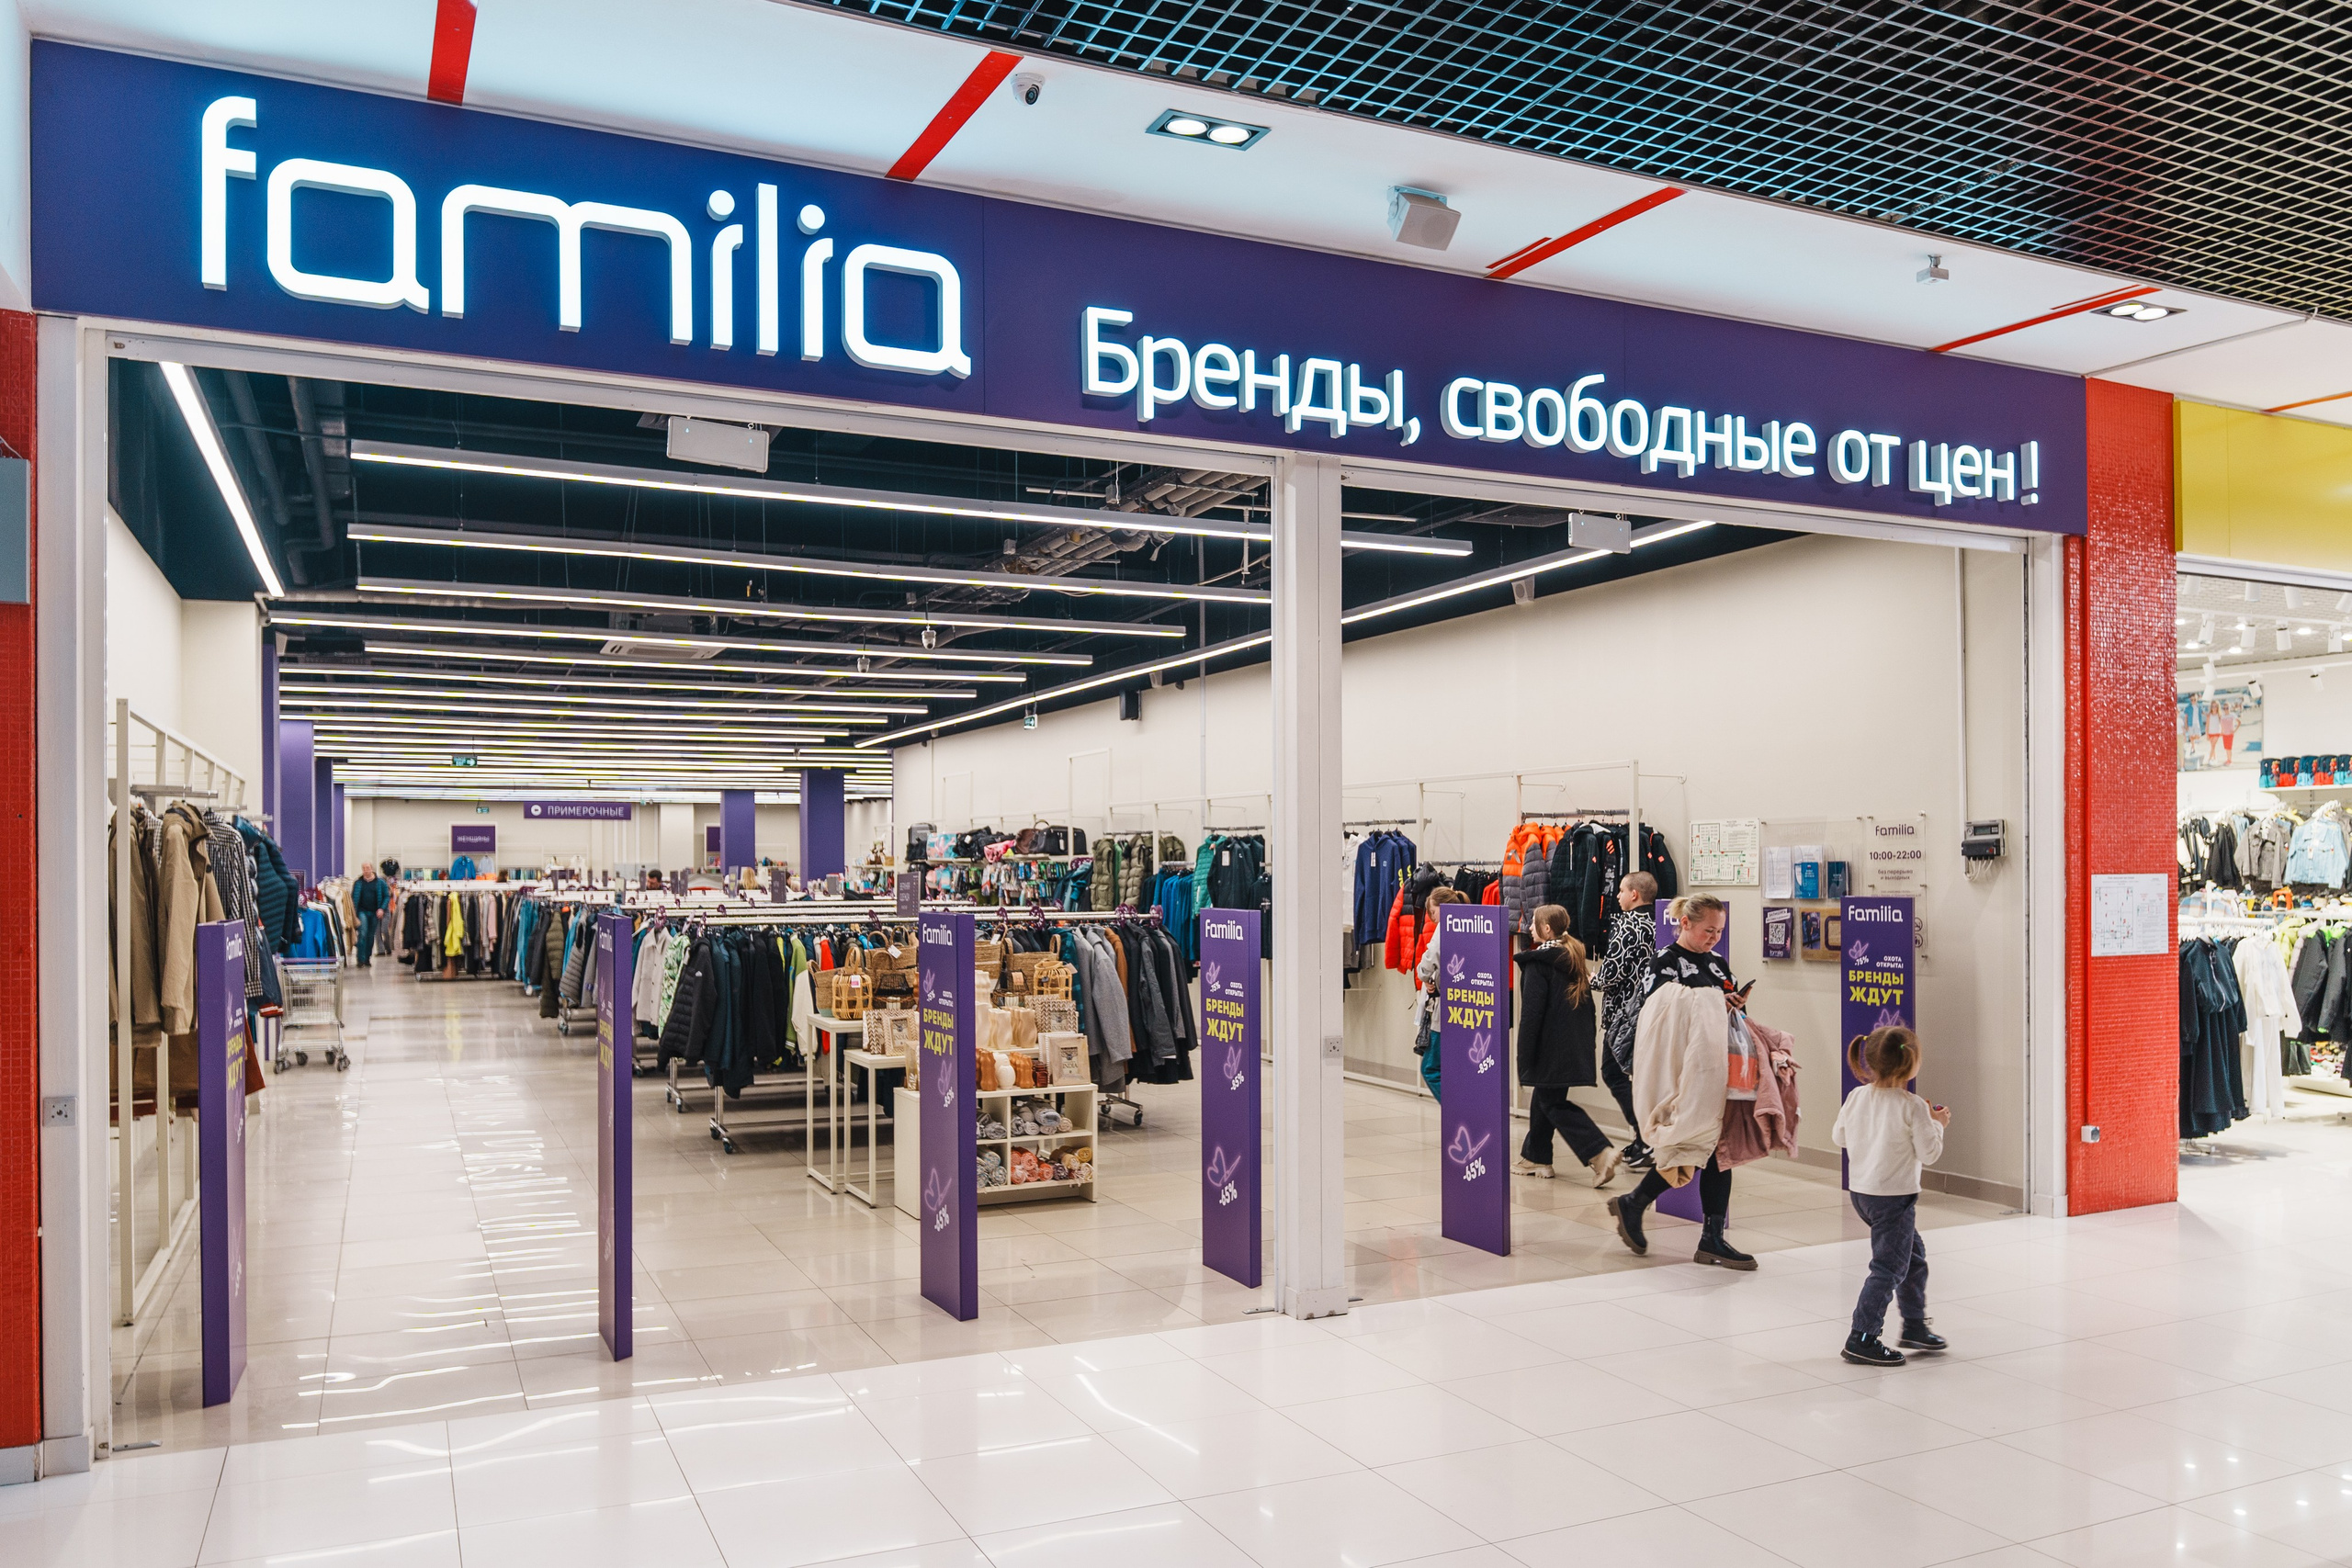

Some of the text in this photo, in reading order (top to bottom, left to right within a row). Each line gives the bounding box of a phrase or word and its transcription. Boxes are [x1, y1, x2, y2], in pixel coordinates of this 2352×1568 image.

[201, 96, 972, 379] familia
[1081, 306, 1421, 447] Бренды,
[1440, 373, 1817, 479] свободные
[1828, 429, 1901, 488] от
[547, 805, 625, 818] ПРИМЕРОЧНЫЕ
[1875, 823, 1915, 837] familia
[1869, 850, 1922, 861] 10:00-22:00
[1446, 914, 1494, 934] familia
[1849, 905, 1904, 922] familia
[922, 923, 953, 946] familia
[1204, 919, 1244, 941] familia
[1849, 970, 1904, 987] БРЕНДЫ
[1447, 987, 1495, 1007] БРЕНДЫ
[1849, 986, 1904, 1006] ЖДУТ
[922, 1008, 954, 1030] БРЕНДЫ
[1205, 998, 1244, 1019] БРЕНДЫ
[1448, 1006, 1495, 1030] ЖДУТ
[1206, 1017, 1244, 1043] ЖДУТ
[923, 1029, 954, 1056] ЖДУТ
[1477, 1055, 1495, 1075] -85%
[1463, 1156, 1486, 1182] -65%
[1219, 1180, 1238, 1206] -65%
